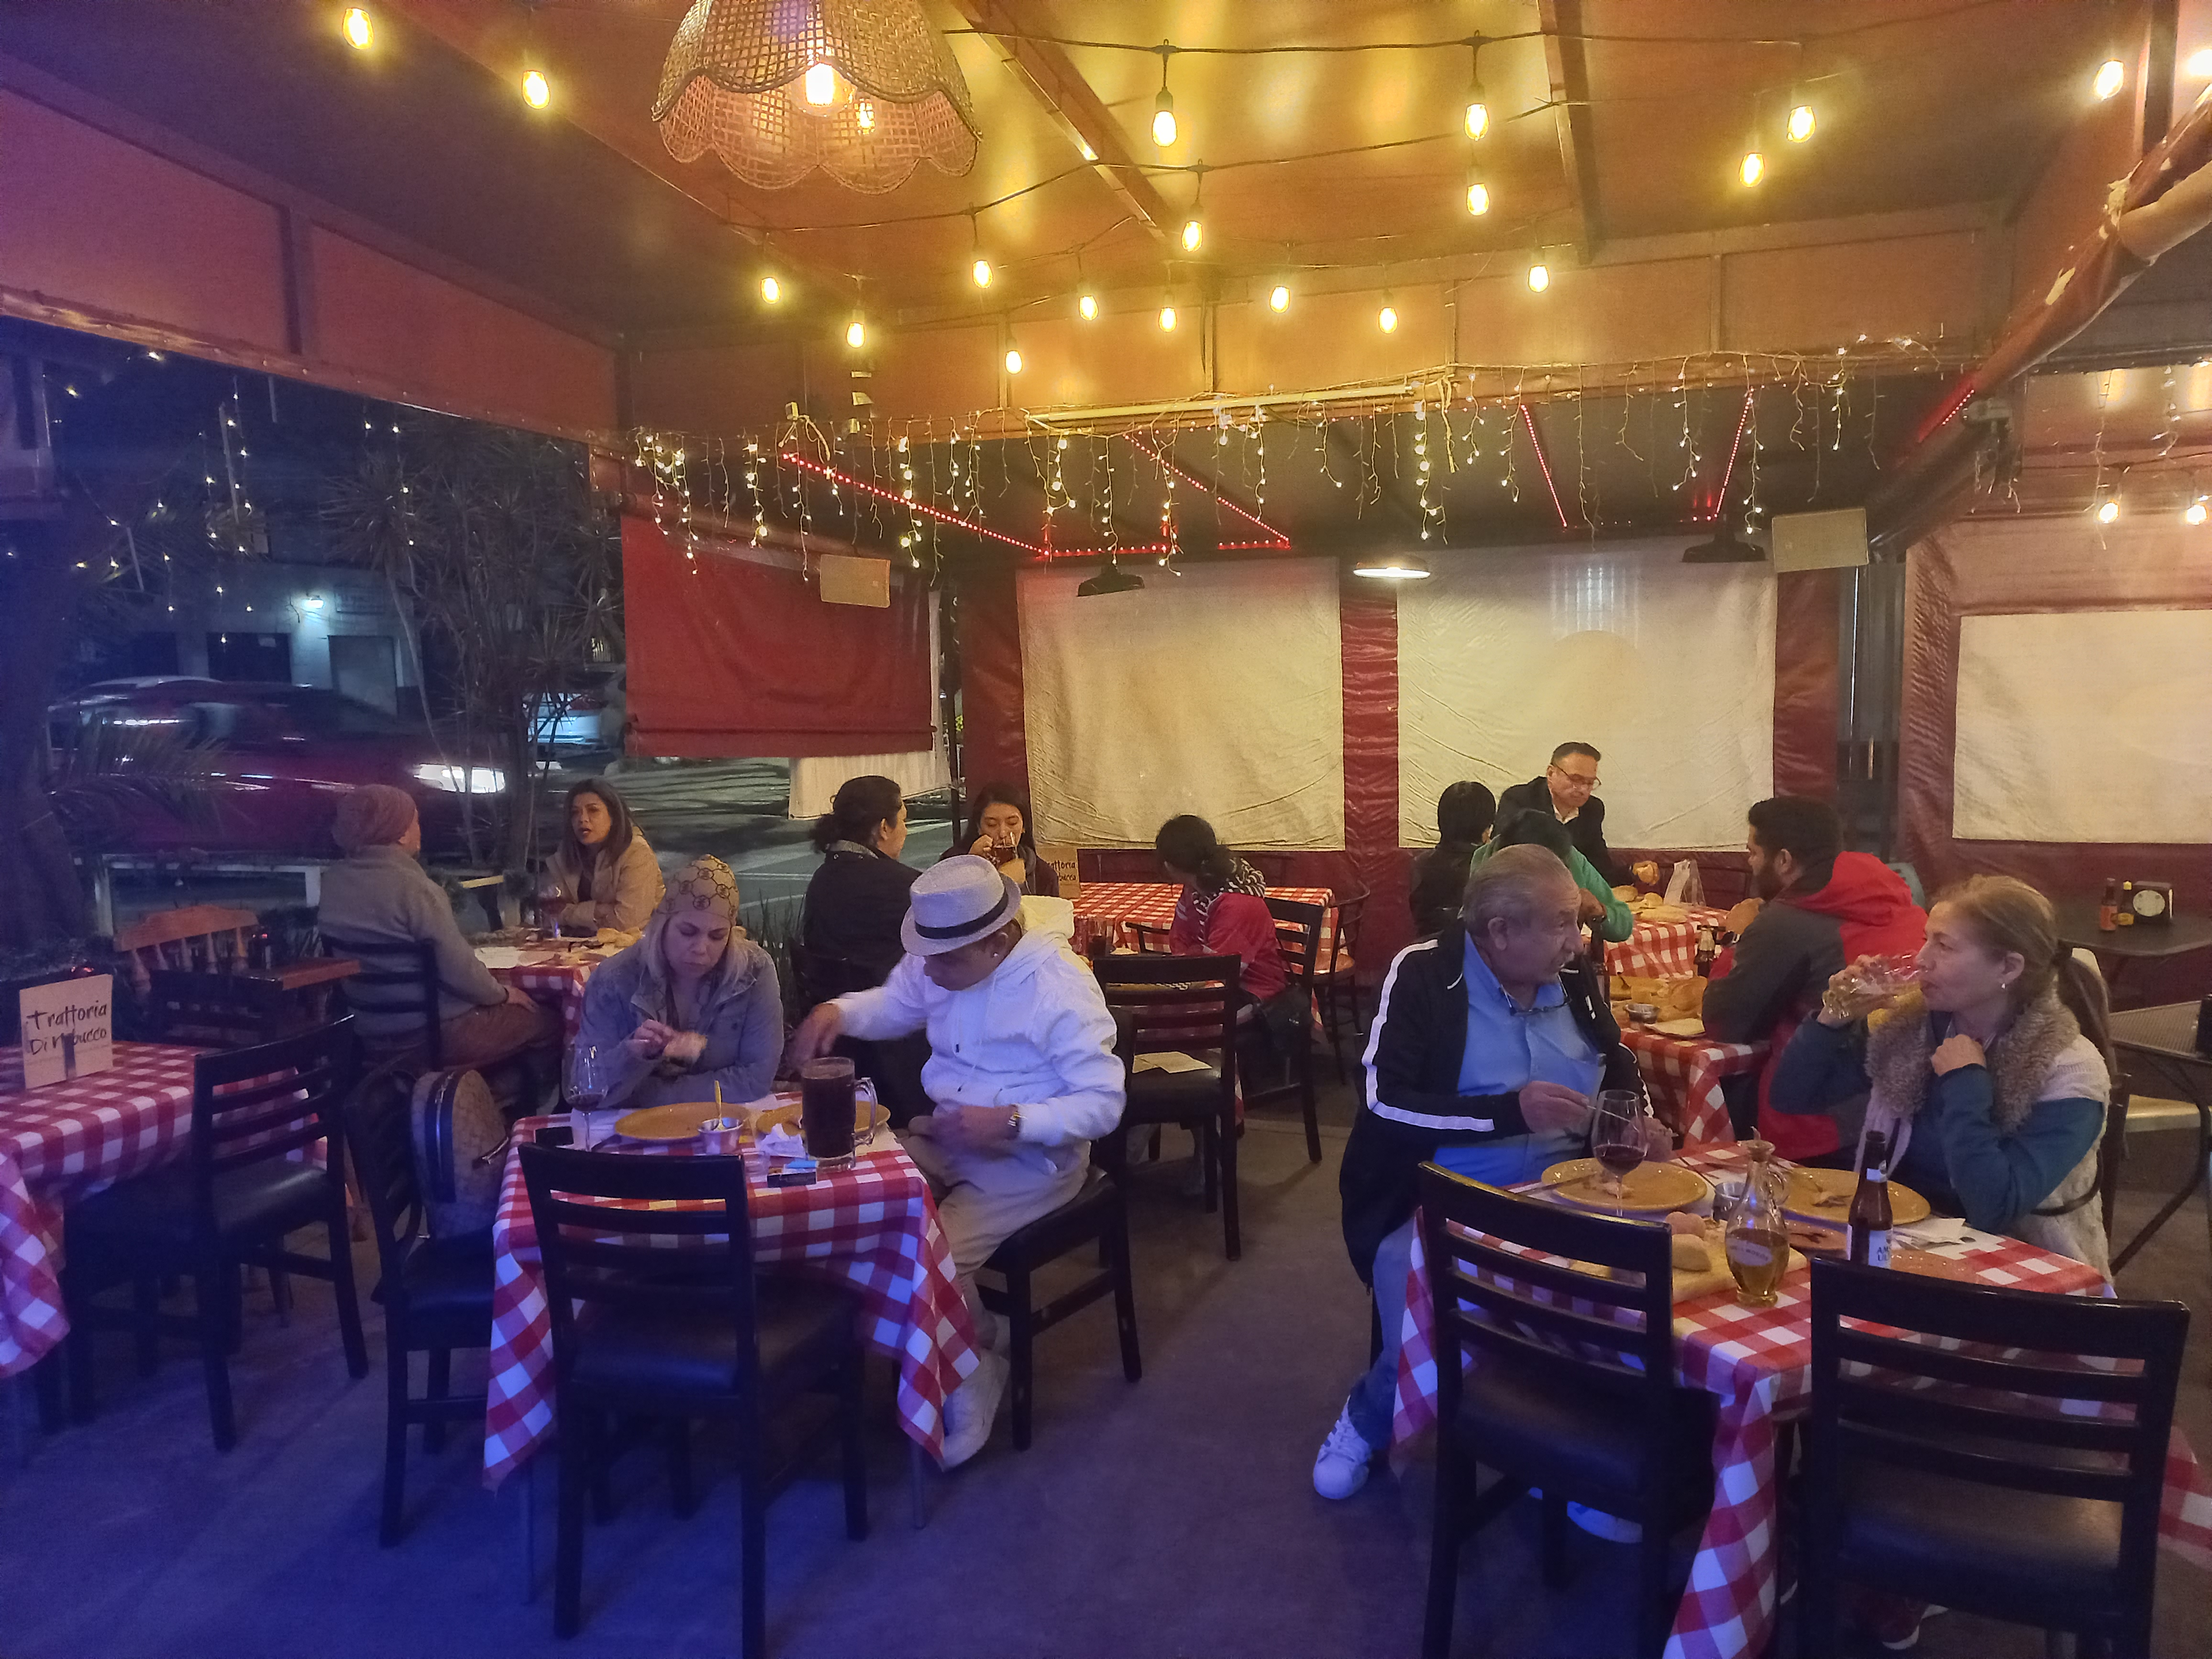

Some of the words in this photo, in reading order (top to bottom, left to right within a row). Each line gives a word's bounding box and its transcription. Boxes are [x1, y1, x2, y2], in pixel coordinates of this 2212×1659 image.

[1046, 860, 1075, 871] attoria
[26, 1000, 107, 1030] Trattoria
[30, 1037, 47, 1055] Di
